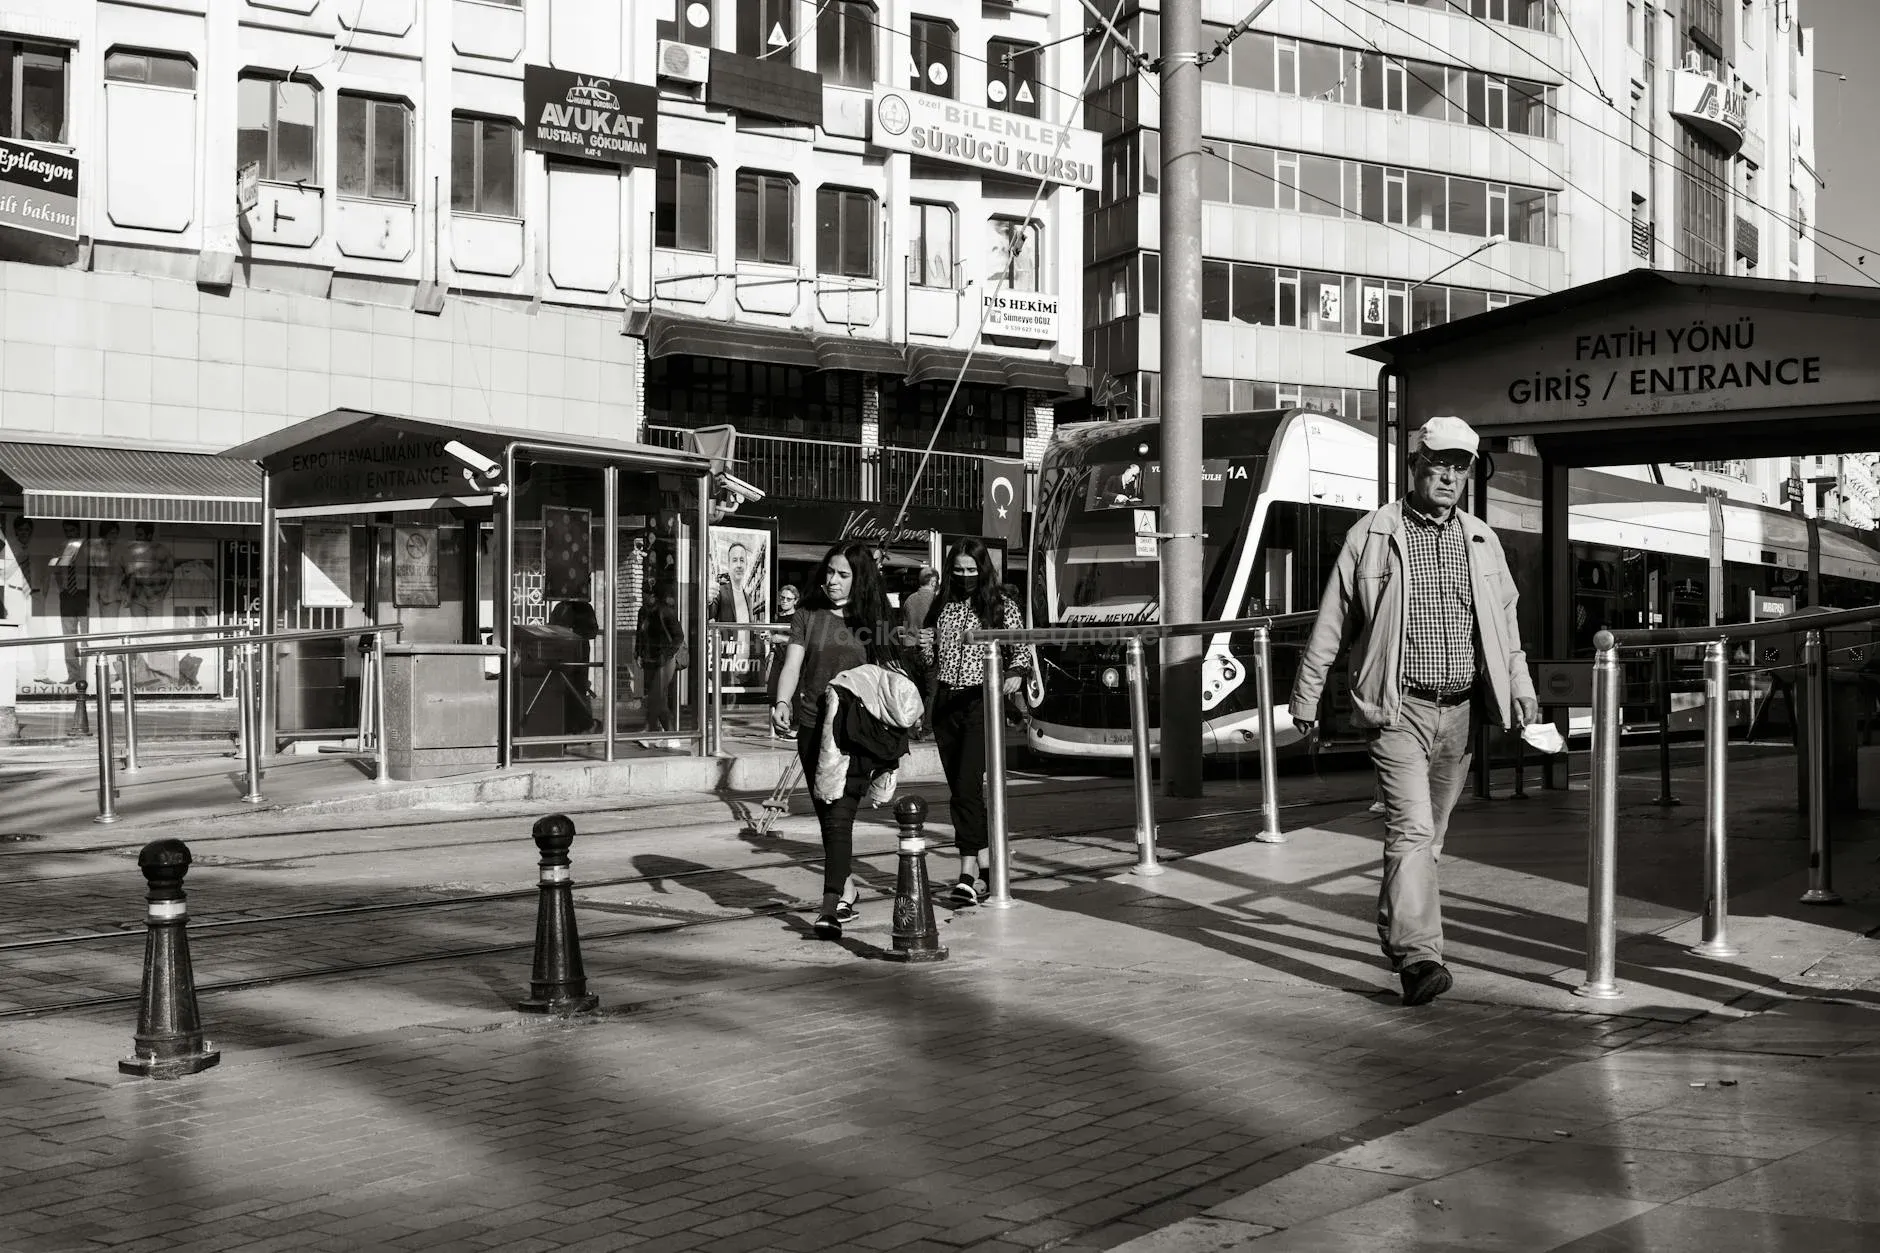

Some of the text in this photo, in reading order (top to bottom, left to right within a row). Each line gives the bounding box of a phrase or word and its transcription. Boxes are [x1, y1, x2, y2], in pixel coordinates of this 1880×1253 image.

[540, 102, 644, 138] AVUKAT
[537, 127, 647, 155] MUSTAFA GÖKDUMAN
[911, 125, 1094, 185] SÜRÜCÜ KURSU
[0, 148, 74, 182] Epilasyon
[22, 199, 76, 226] bakımı
[1010, 299, 1057, 314] HEKİMİ
[1575, 317, 1755, 361] FATİH YÖNÜ
[1508, 356, 1820, 407] GİRİŞ / ENTRANCE
[292, 451, 328, 472] EXPO
[366, 466, 449, 489] ENTRANCE
